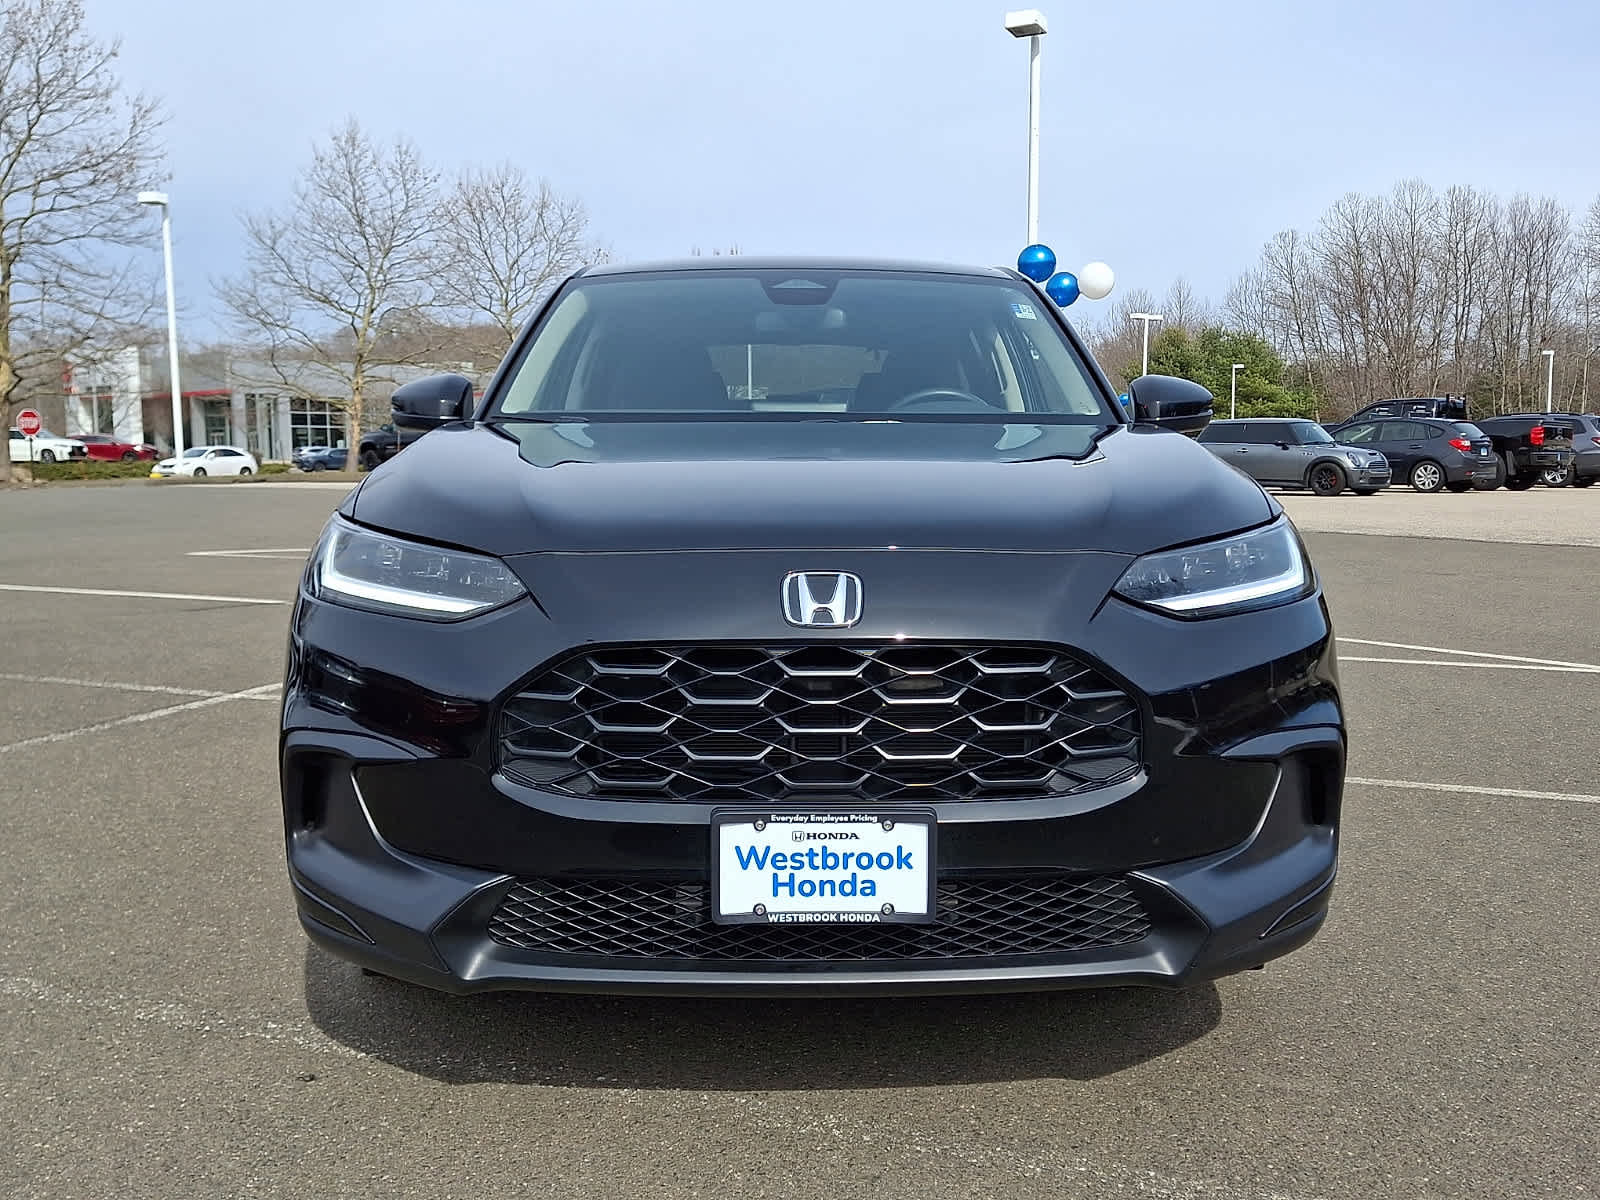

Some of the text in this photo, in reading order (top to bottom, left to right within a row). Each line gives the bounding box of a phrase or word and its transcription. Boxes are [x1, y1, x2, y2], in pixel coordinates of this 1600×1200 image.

[19, 417, 38, 429] STOP
[771, 814, 878, 824] Everyday Employee Pricing
[806, 832, 860, 840] HONDA
[735, 845, 914, 870] Westbrook
[772, 872, 877, 897] Honda
[767, 913, 880, 923] WESTBROOK HONDA
